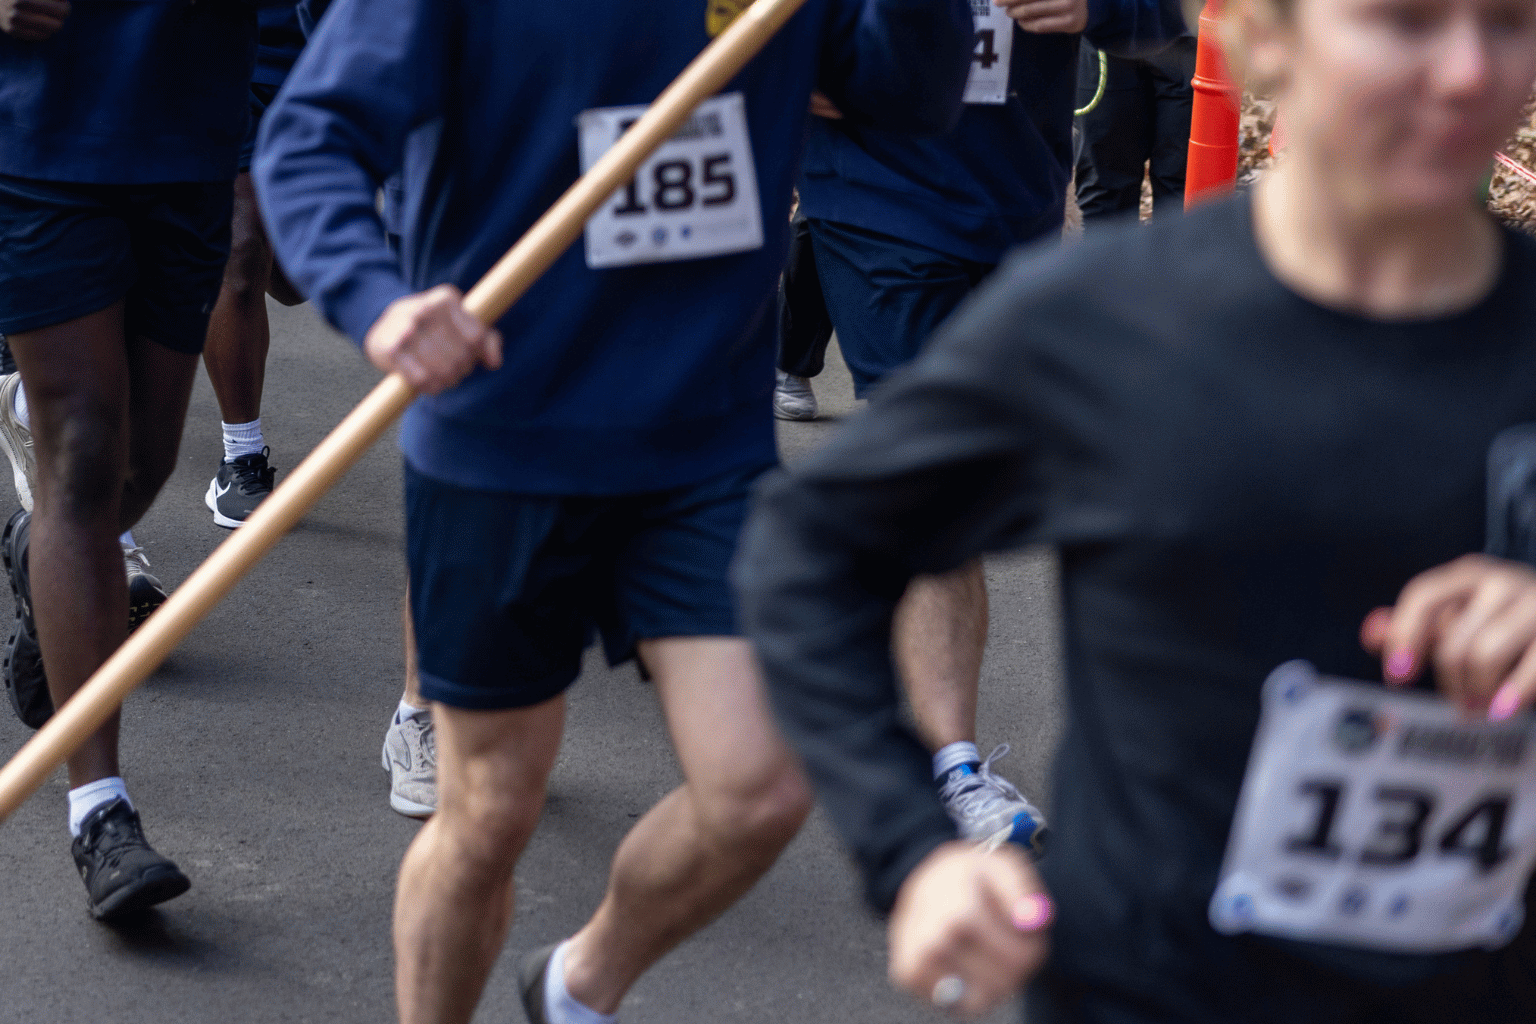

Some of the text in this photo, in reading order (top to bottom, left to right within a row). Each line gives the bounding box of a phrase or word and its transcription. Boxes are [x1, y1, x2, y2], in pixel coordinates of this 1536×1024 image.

[971, 28, 1000, 70] 4
[611, 152, 737, 219] 185
[1280, 776, 1514, 876] 134
